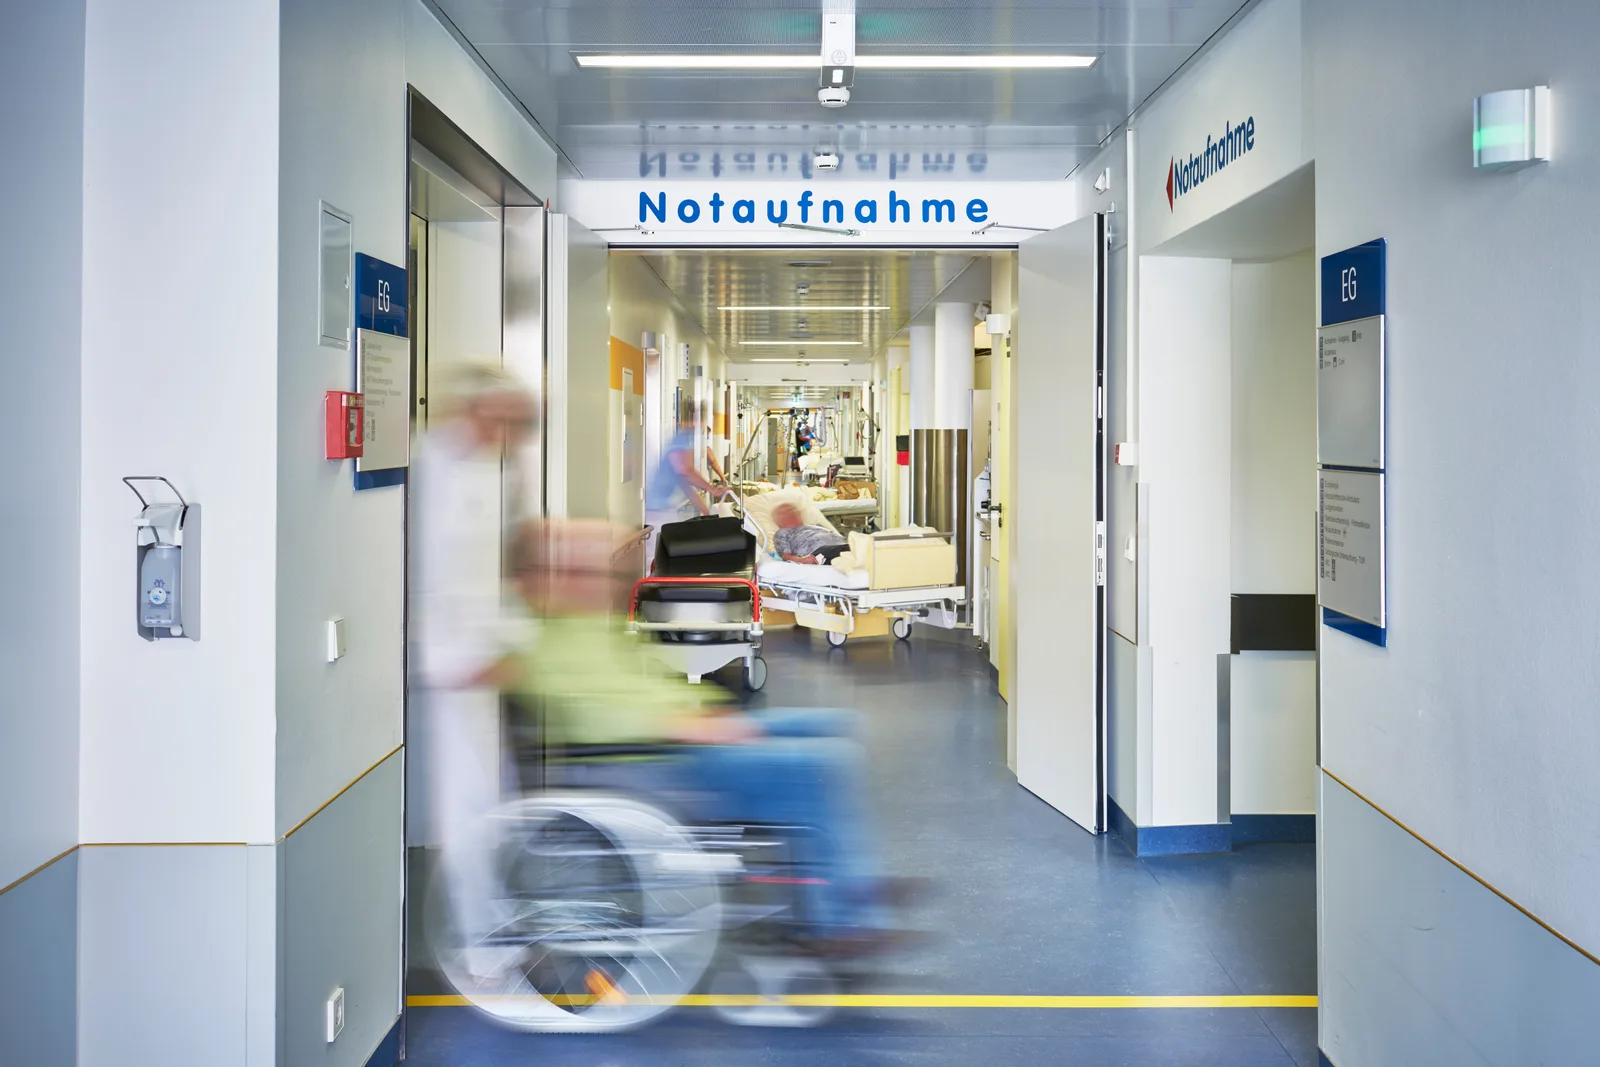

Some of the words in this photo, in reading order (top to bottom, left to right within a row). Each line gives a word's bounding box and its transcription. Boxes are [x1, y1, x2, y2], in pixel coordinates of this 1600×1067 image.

[1174, 116, 1255, 200] Notaufnahme
[639, 191, 989, 224] Notaufnahme
[378, 279, 390, 313] EG
[1341, 266, 1357, 302] EG
